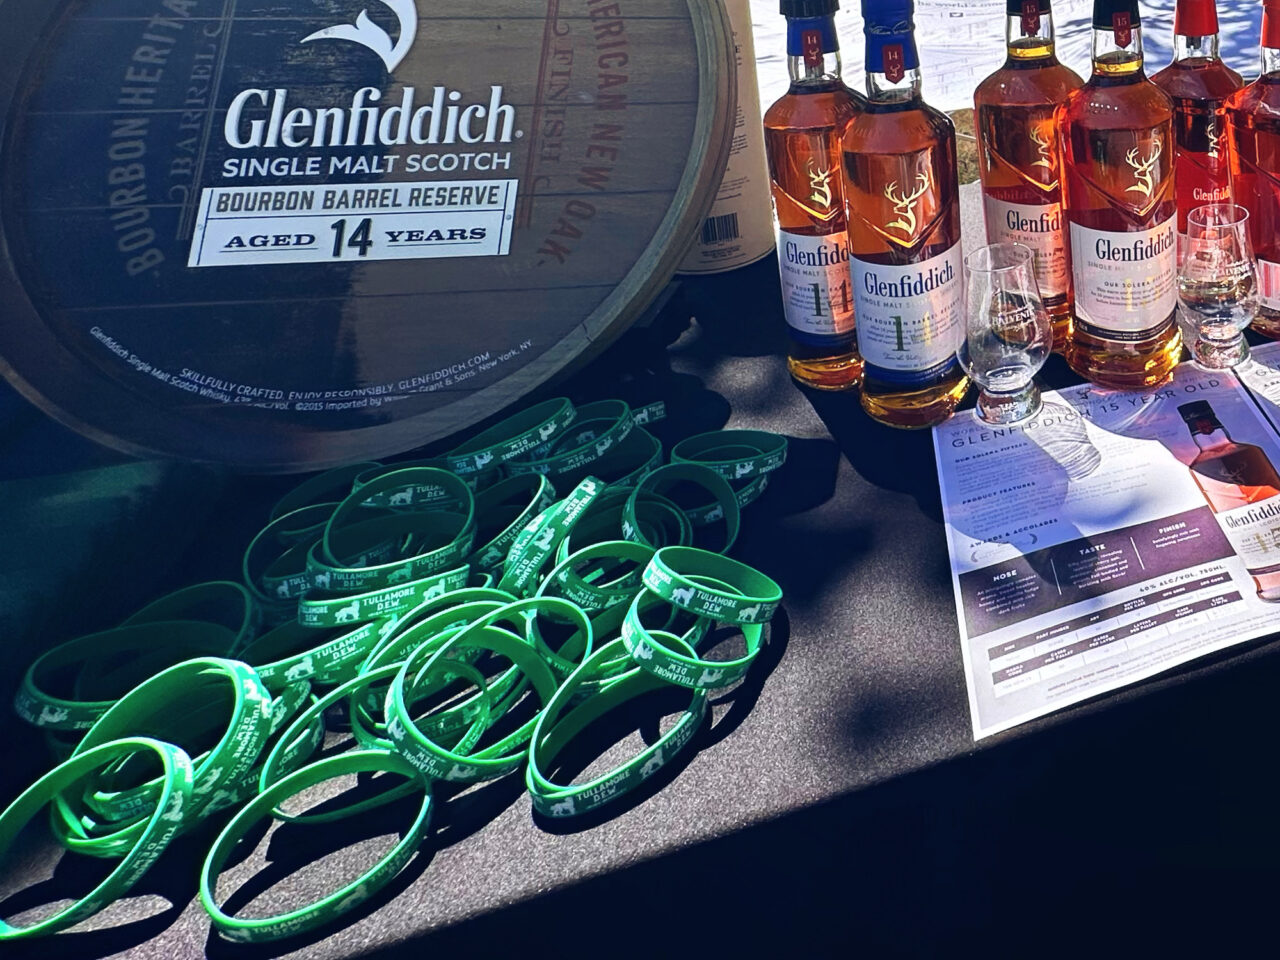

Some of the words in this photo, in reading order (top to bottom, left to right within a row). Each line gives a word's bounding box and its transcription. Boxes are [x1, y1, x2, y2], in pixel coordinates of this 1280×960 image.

[1116, 18, 1127, 28] 15
[806, 35, 817, 45] 14
[887, 50, 899, 61] 14
[224, 86, 516, 149] Glenfiddich
[539, 47, 574, 164] FINISH
[222, 156, 321, 177] SINGLE
[329, 154, 400, 175] MALT
[405, 152, 511, 173] SCOTCH
[577, 123, 625, 190] NEW
[108, 118, 166, 277] BOURBON
[216, 190, 314, 213] BOURBON
[322, 187, 402, 210] BARREL
[408, 185, 501, 208] RESERVE
[537, 199, 596, 264] OAK
[1006, 210, 1060, 233] Glenfid
[224, 233, 316, 249] AGED
[330, 218, 373, 258] 14
[385, 227, 487, 243] YEARS
[1096, 226, 1175, 262] Glenfiddich
[786, 241, 849, 266] Glenfidd
[864, 260, 953, 298] Glenfiddich
[883, 300, 903, 309] MALT
[179, 368, 237, 392] SKILLFULLY
[398, 351, 491, 391] GLENFIDDICH.COM
[325, 398, 368, 411] Imported
[370, 398, 383, 408] by
[479, 360, 498, 373] New
[520, 339, 532, 351] NY
[952, 409, 1091, 448] GLENFIDDICH
[1100, 402, 1120, 414] 15
[1128, 389, 1177, 408] YEAR
[1184, 379, 1222, 394] OLD
[954, 456, 971, 464] OUR
[972, 450, 999, 459] SOLERA
[1000, 442, 1028, 453] FIFTEEN
[962, 492, 998, 505] PRODUCT
[1000, 482, 1036, 494] FEATURES
[562, 493, 593, 527] TULLAMORE
[970, 536, 1004, 549] AWARDS
[1013, 518, 1059, 535] ACCOLADES
[1158, 522, 1187, 534] FINISH
[1079, 543, 1106, 555] TASTE
[332, 570, 379, 581] TULLAMORE
[514, 551, 545, 588] TULLAMORE
[992, 569, 1018, 583] NOSE
[362, 586, 416, 606] TULLAMORE
[697, 590, 738, 608] TULLAMORE
[315, 628, 371, 660] TULLAMORE
[653, 666, 695, 687] TULLAMORE
[402, 749, 444, 778] TULLAMORE
[576, 770, 631, 801] TULLAMORE
[252, 910, 321, 934] TULLAMORE
